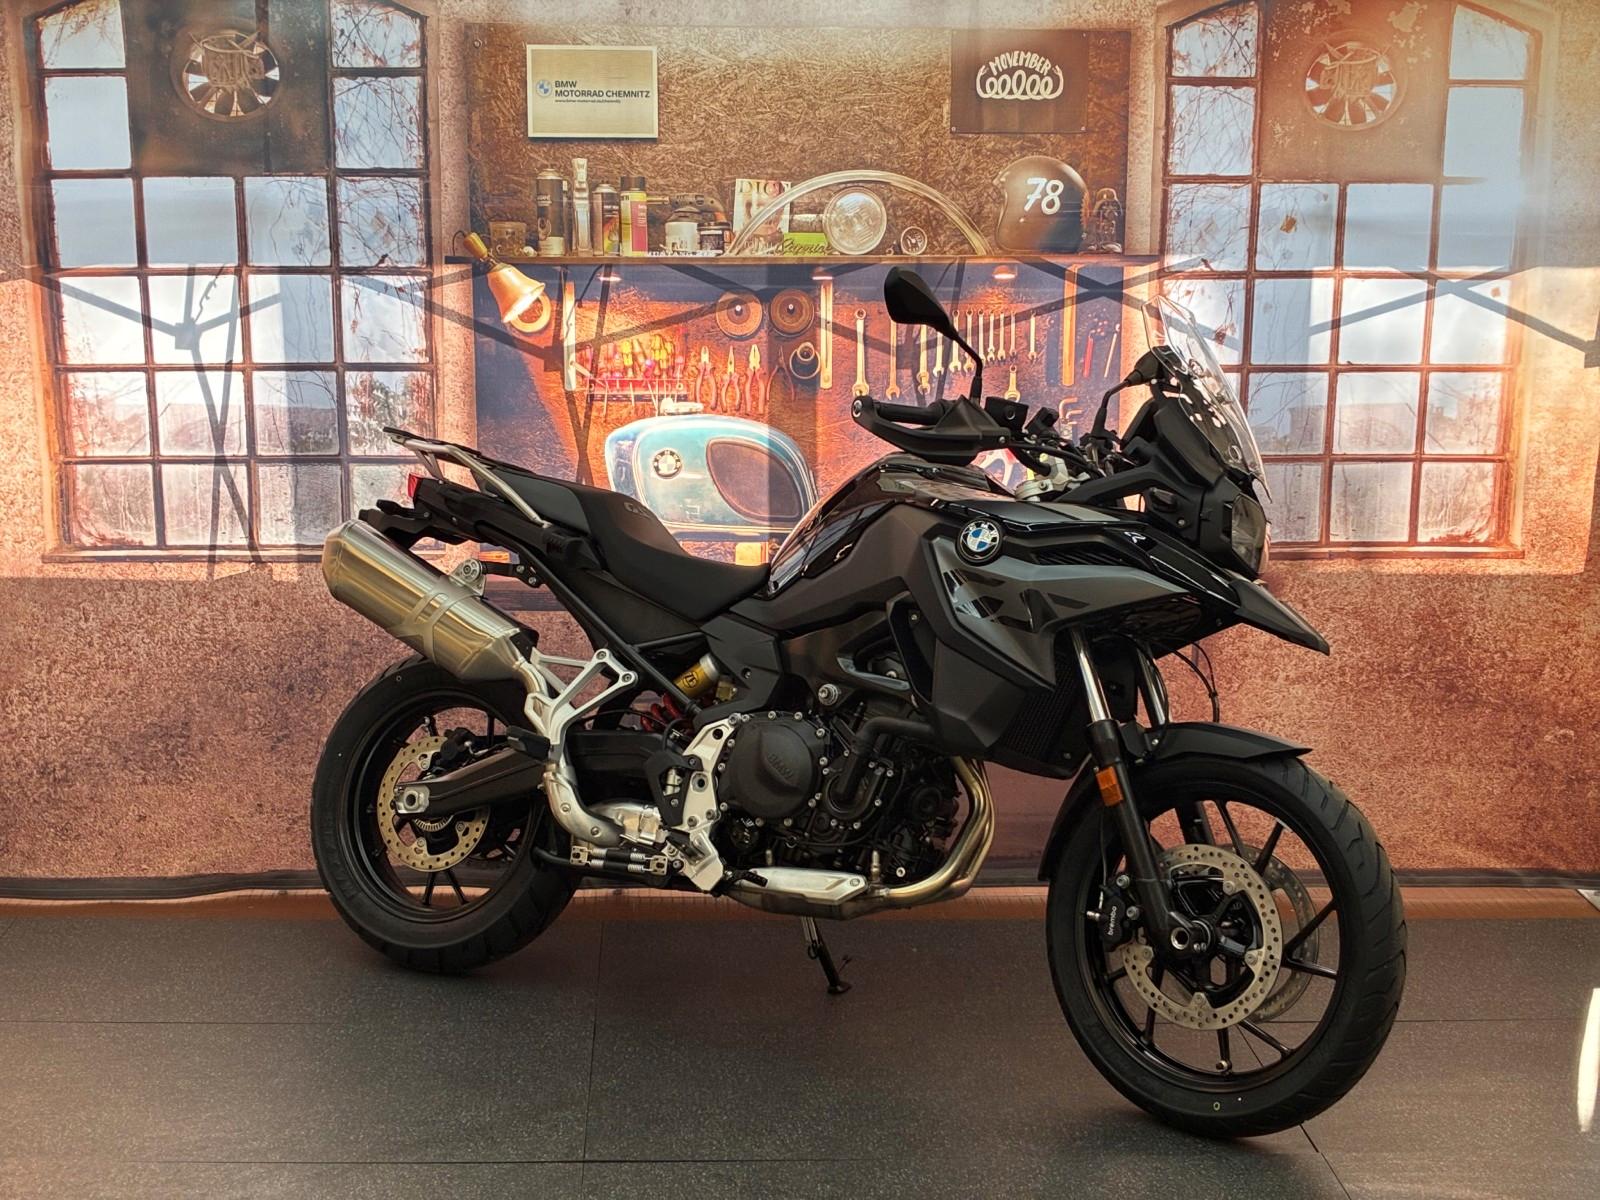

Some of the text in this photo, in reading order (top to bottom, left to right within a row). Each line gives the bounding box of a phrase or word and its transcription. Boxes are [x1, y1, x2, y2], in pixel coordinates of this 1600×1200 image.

[989, 50, 1052, 76] MOVEMBER
[555, 80, 577, 88] BMW
[555, 89, 651, 98] MOTORRAD CHEMNITZ
[1024, 177, 1064, 215] 78
[1107, 905, 1117, 936] brembo
